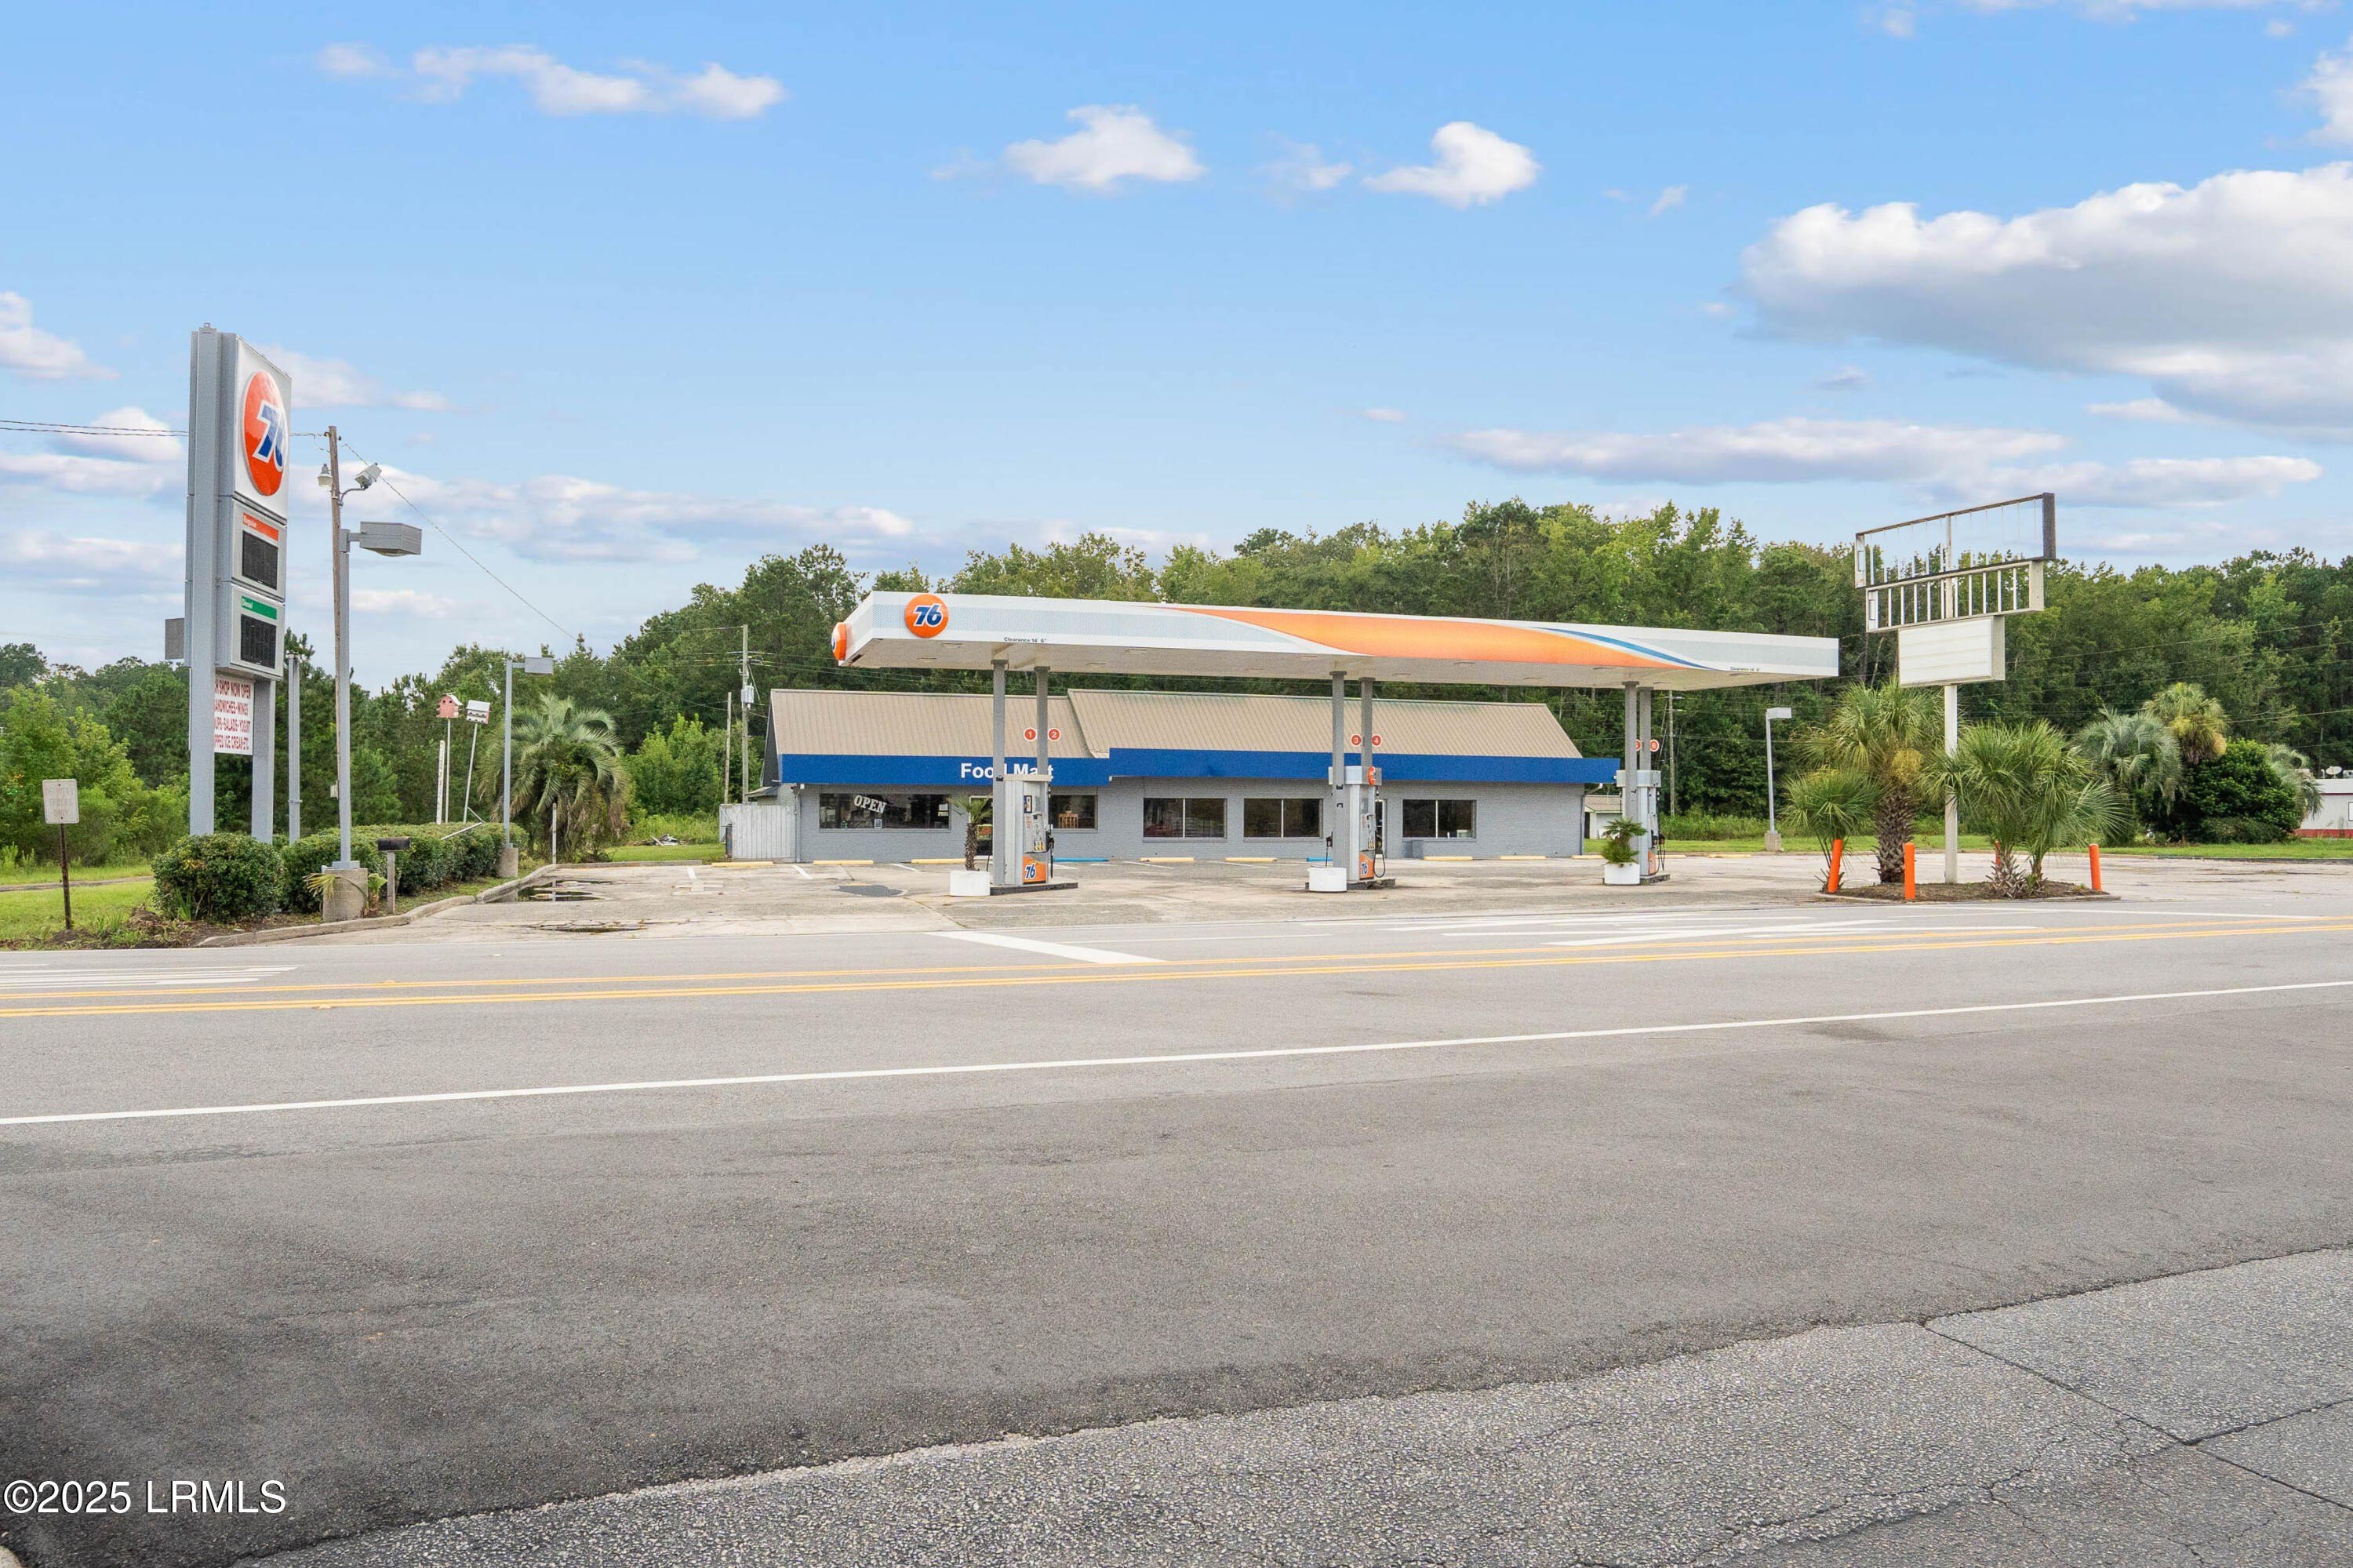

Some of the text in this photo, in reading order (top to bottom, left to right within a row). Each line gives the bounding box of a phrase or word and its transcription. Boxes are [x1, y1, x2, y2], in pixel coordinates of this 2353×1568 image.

[913, 603, 943, 627] 76
[1013, 763, 1054, 779] Mat
[854, 795, 887, 813] OPEN
[1024, 863, 1036, 880] 76
